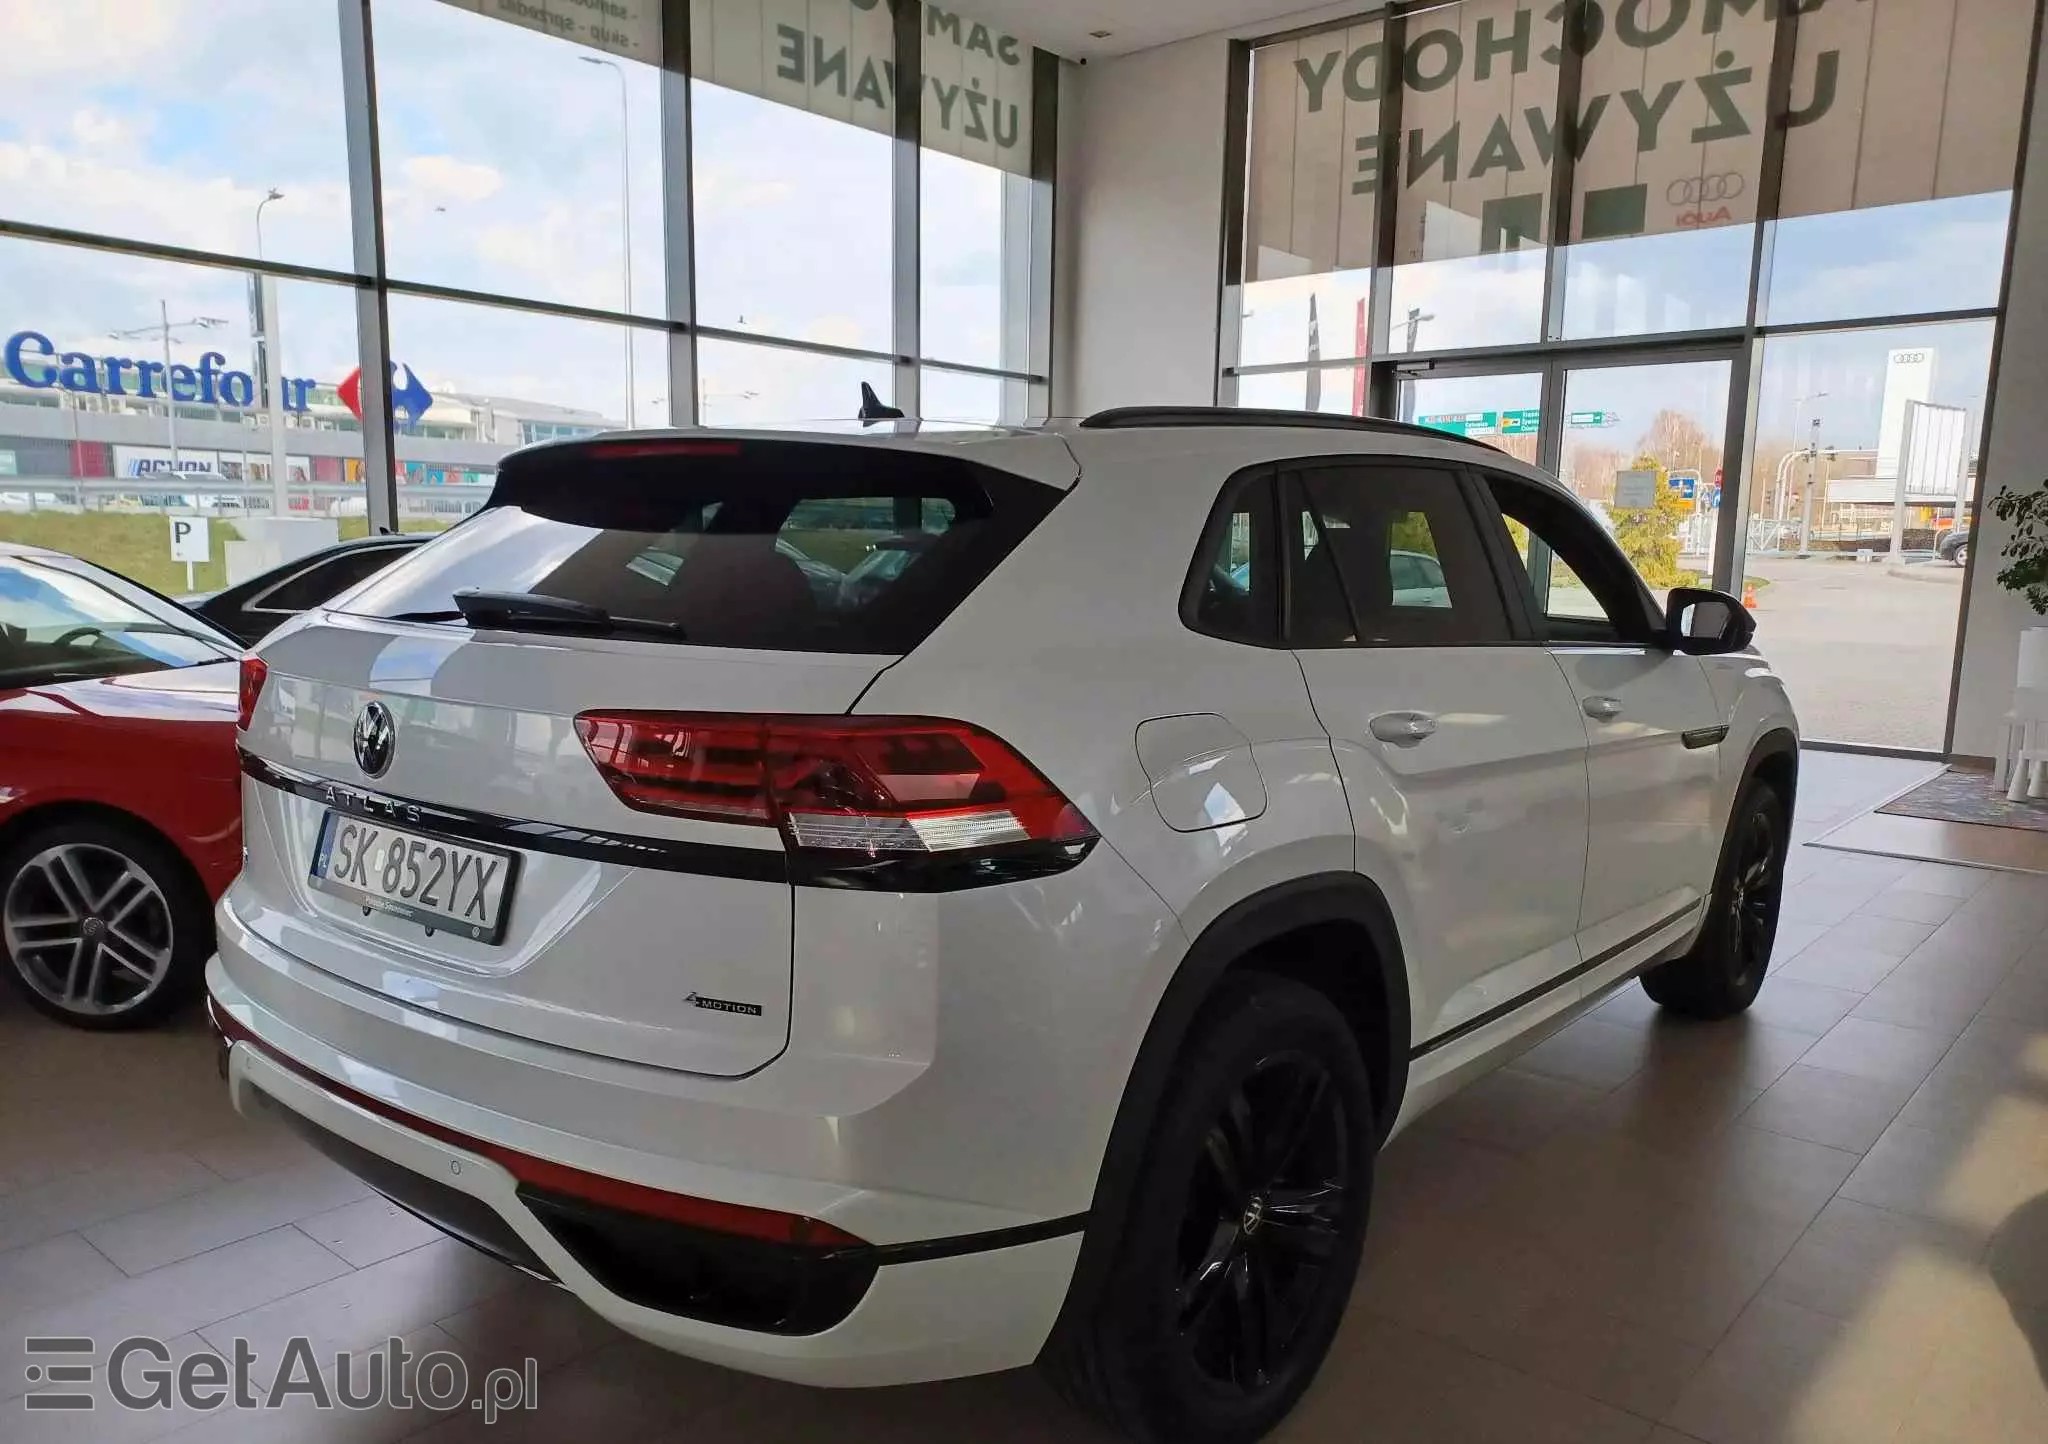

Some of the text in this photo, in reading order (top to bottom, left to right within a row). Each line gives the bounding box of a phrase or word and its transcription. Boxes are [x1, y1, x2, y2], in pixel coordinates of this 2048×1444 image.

[174, 521, 191, 544] P
[326, 786, 421, 823] ATLAS
[334, 824, 498, 921] SK 852YX
